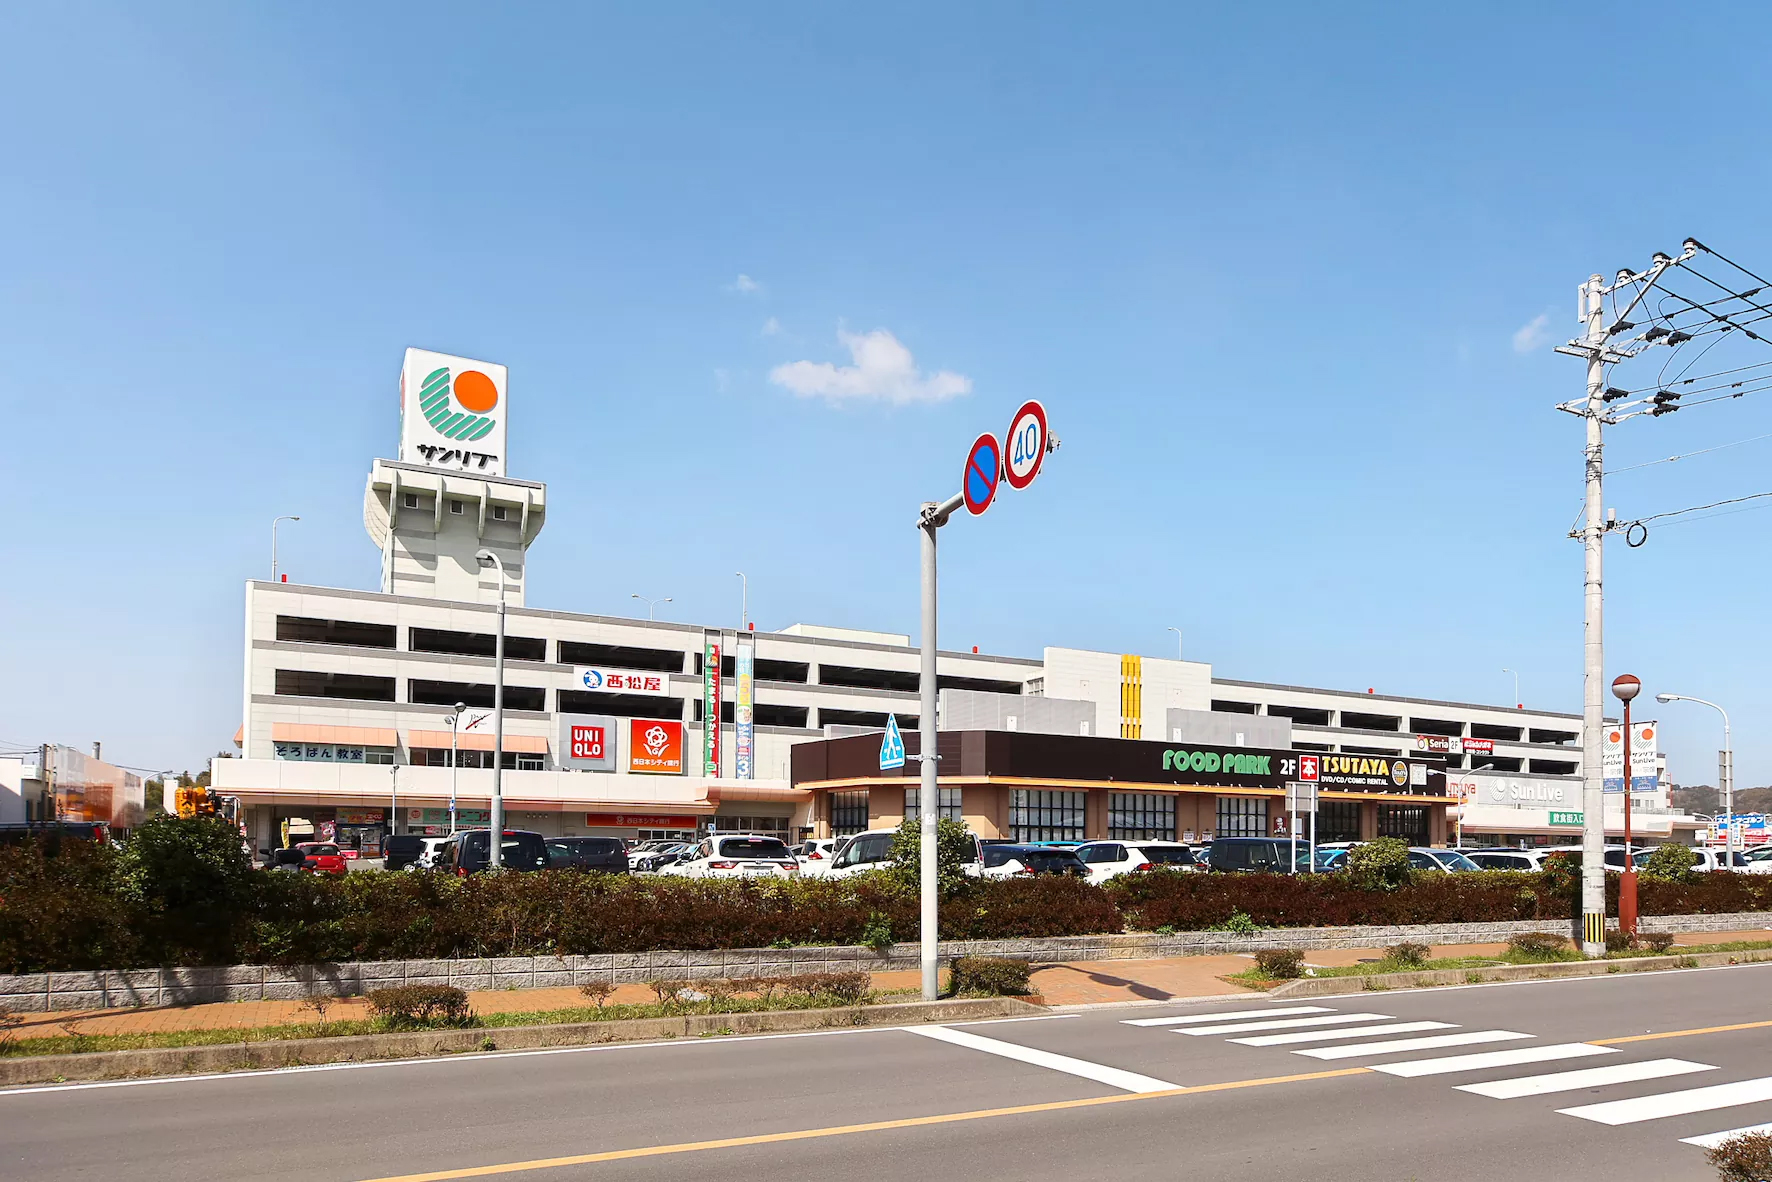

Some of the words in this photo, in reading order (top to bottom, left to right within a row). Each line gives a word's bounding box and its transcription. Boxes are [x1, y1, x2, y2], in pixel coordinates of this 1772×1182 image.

[1014, 423, 1036, 466] 40
[606, 674, 661, 691] 西松屋
[574, 729, 599, 742] UNI
[574, 743, 601, 757] QLO
[1429, 739, 1449, 749] Seria
[1450, 740, 1458, 750] 2F
[275, 746, 363, 760] そろばん教室
[632, 758, 680, 767] 西日本シティ銀行
[1162, 749, 1221, 773] FOOD
[1222, 753, 1271, 775] PARK
[1280, 759, 1297, 775] 2F
[1302, 759, 1316, 777] 本
[1321, 755, 1390, 776] TSUTAYA
[1367, 778, 1388, 786] RENTAL
